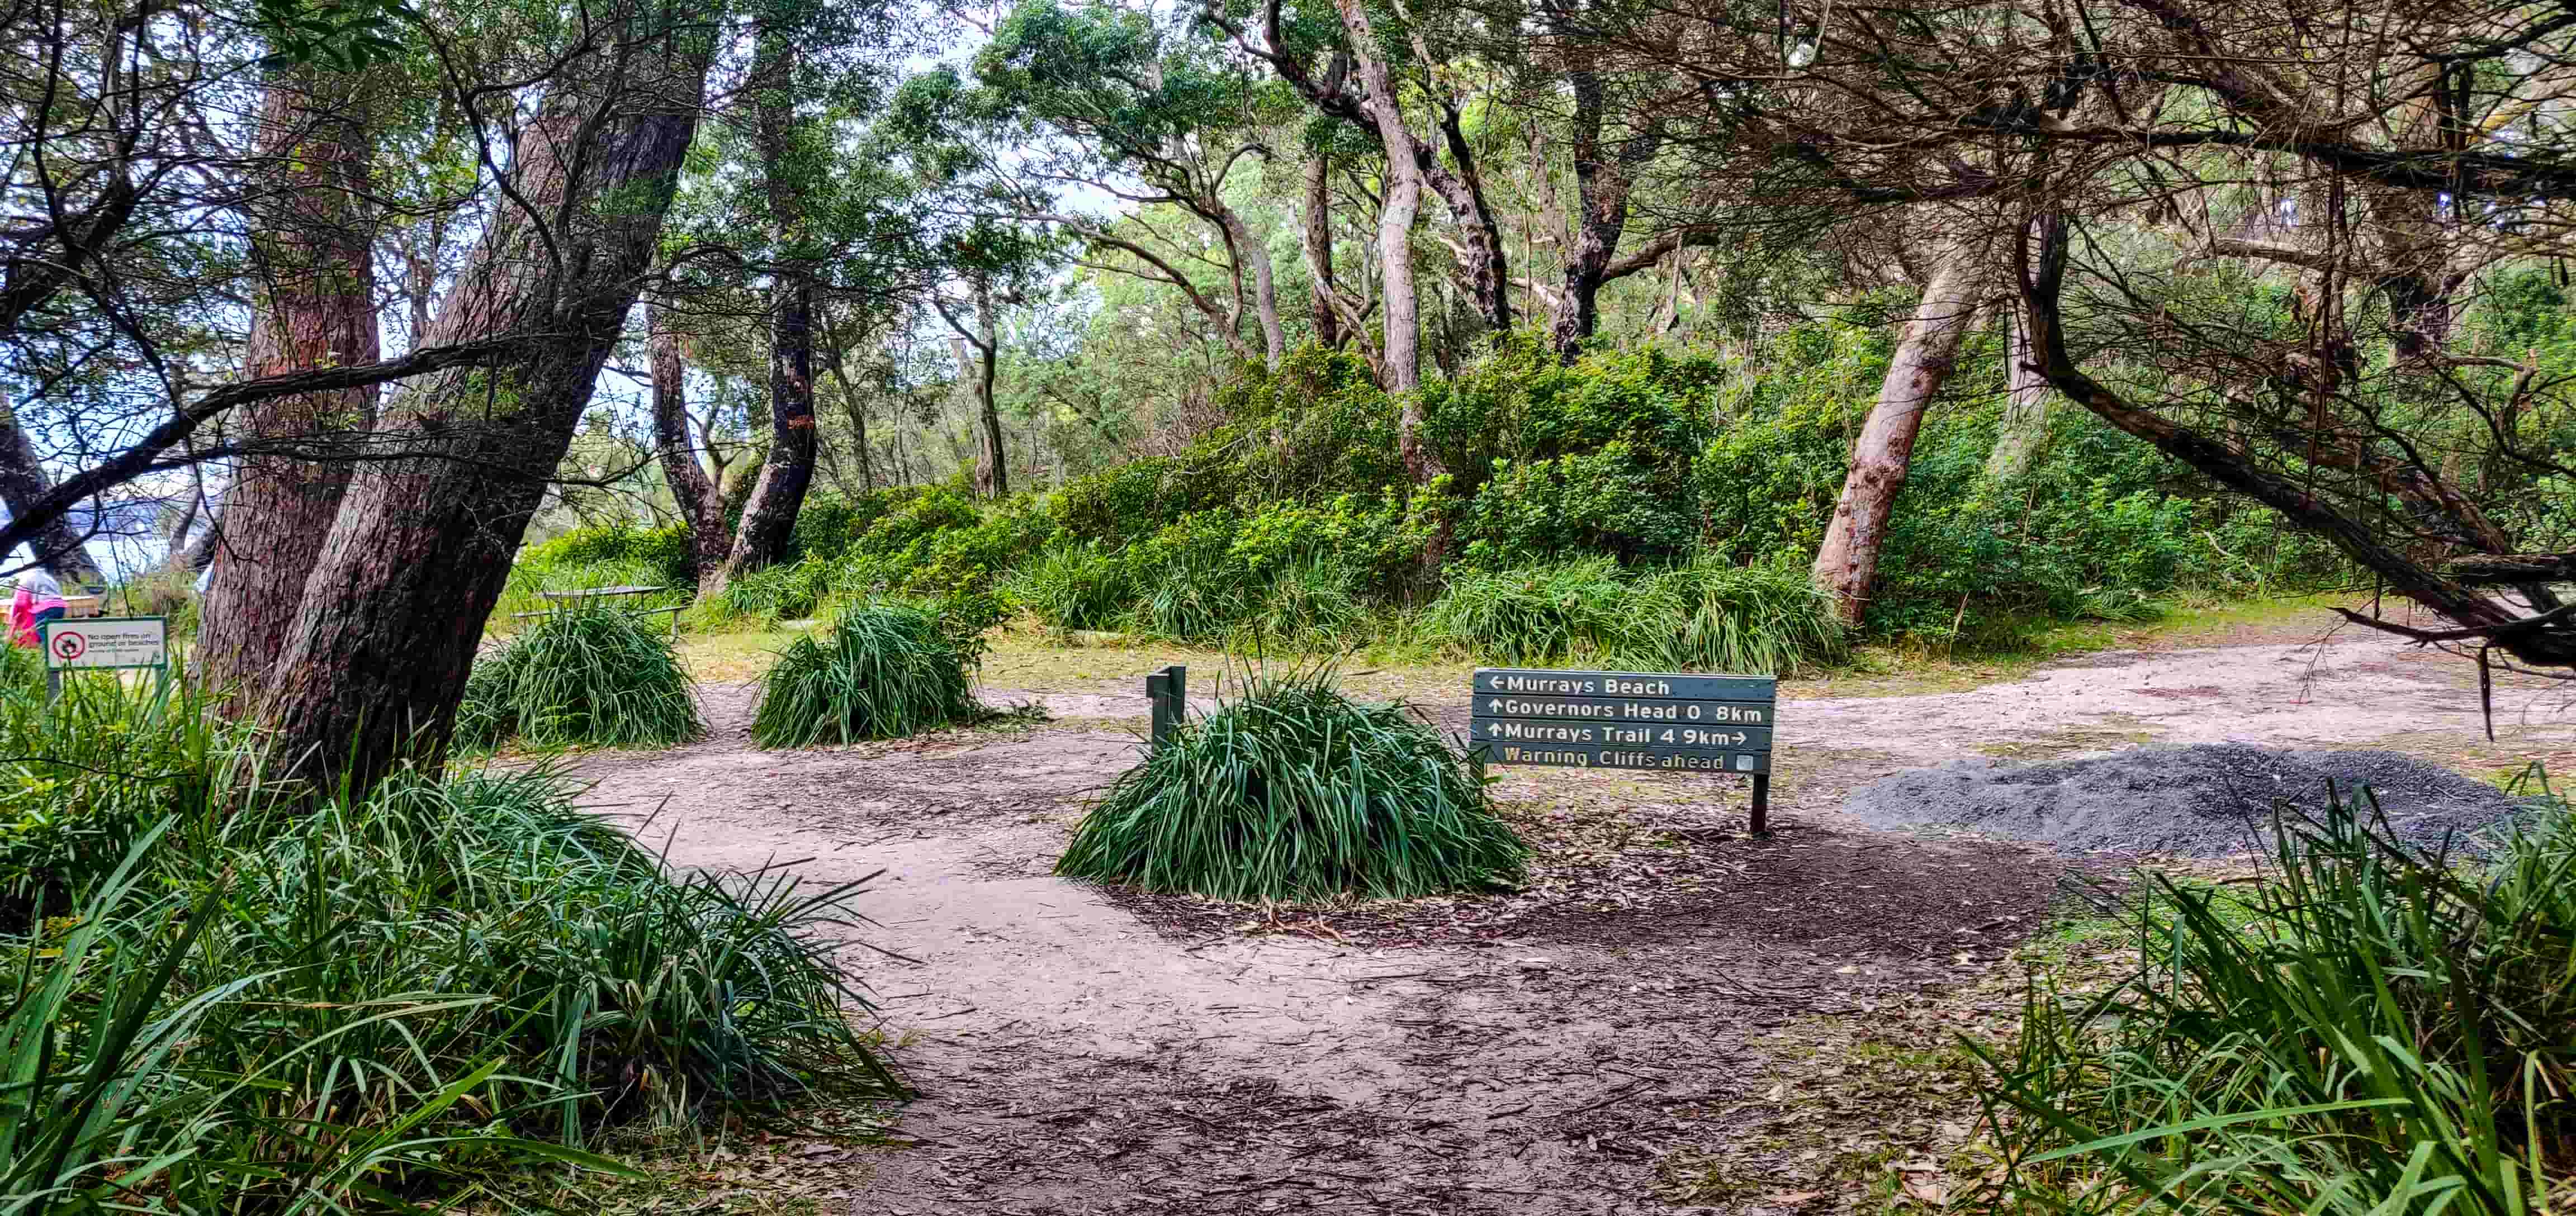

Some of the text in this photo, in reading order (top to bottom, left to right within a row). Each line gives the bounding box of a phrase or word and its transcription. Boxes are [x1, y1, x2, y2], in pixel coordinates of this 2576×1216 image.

[1507, 676, 1670, 694] Murrays Beach
[1505, 699, 1614, 716] Governors
[1624, 703, 1678, 719] Head
[1505, 723, 1592, 742] Murrays
[1604, 727, 1650, 742] Trail
[1503, 747, 1725, 769] Warning Cliffs ahead
